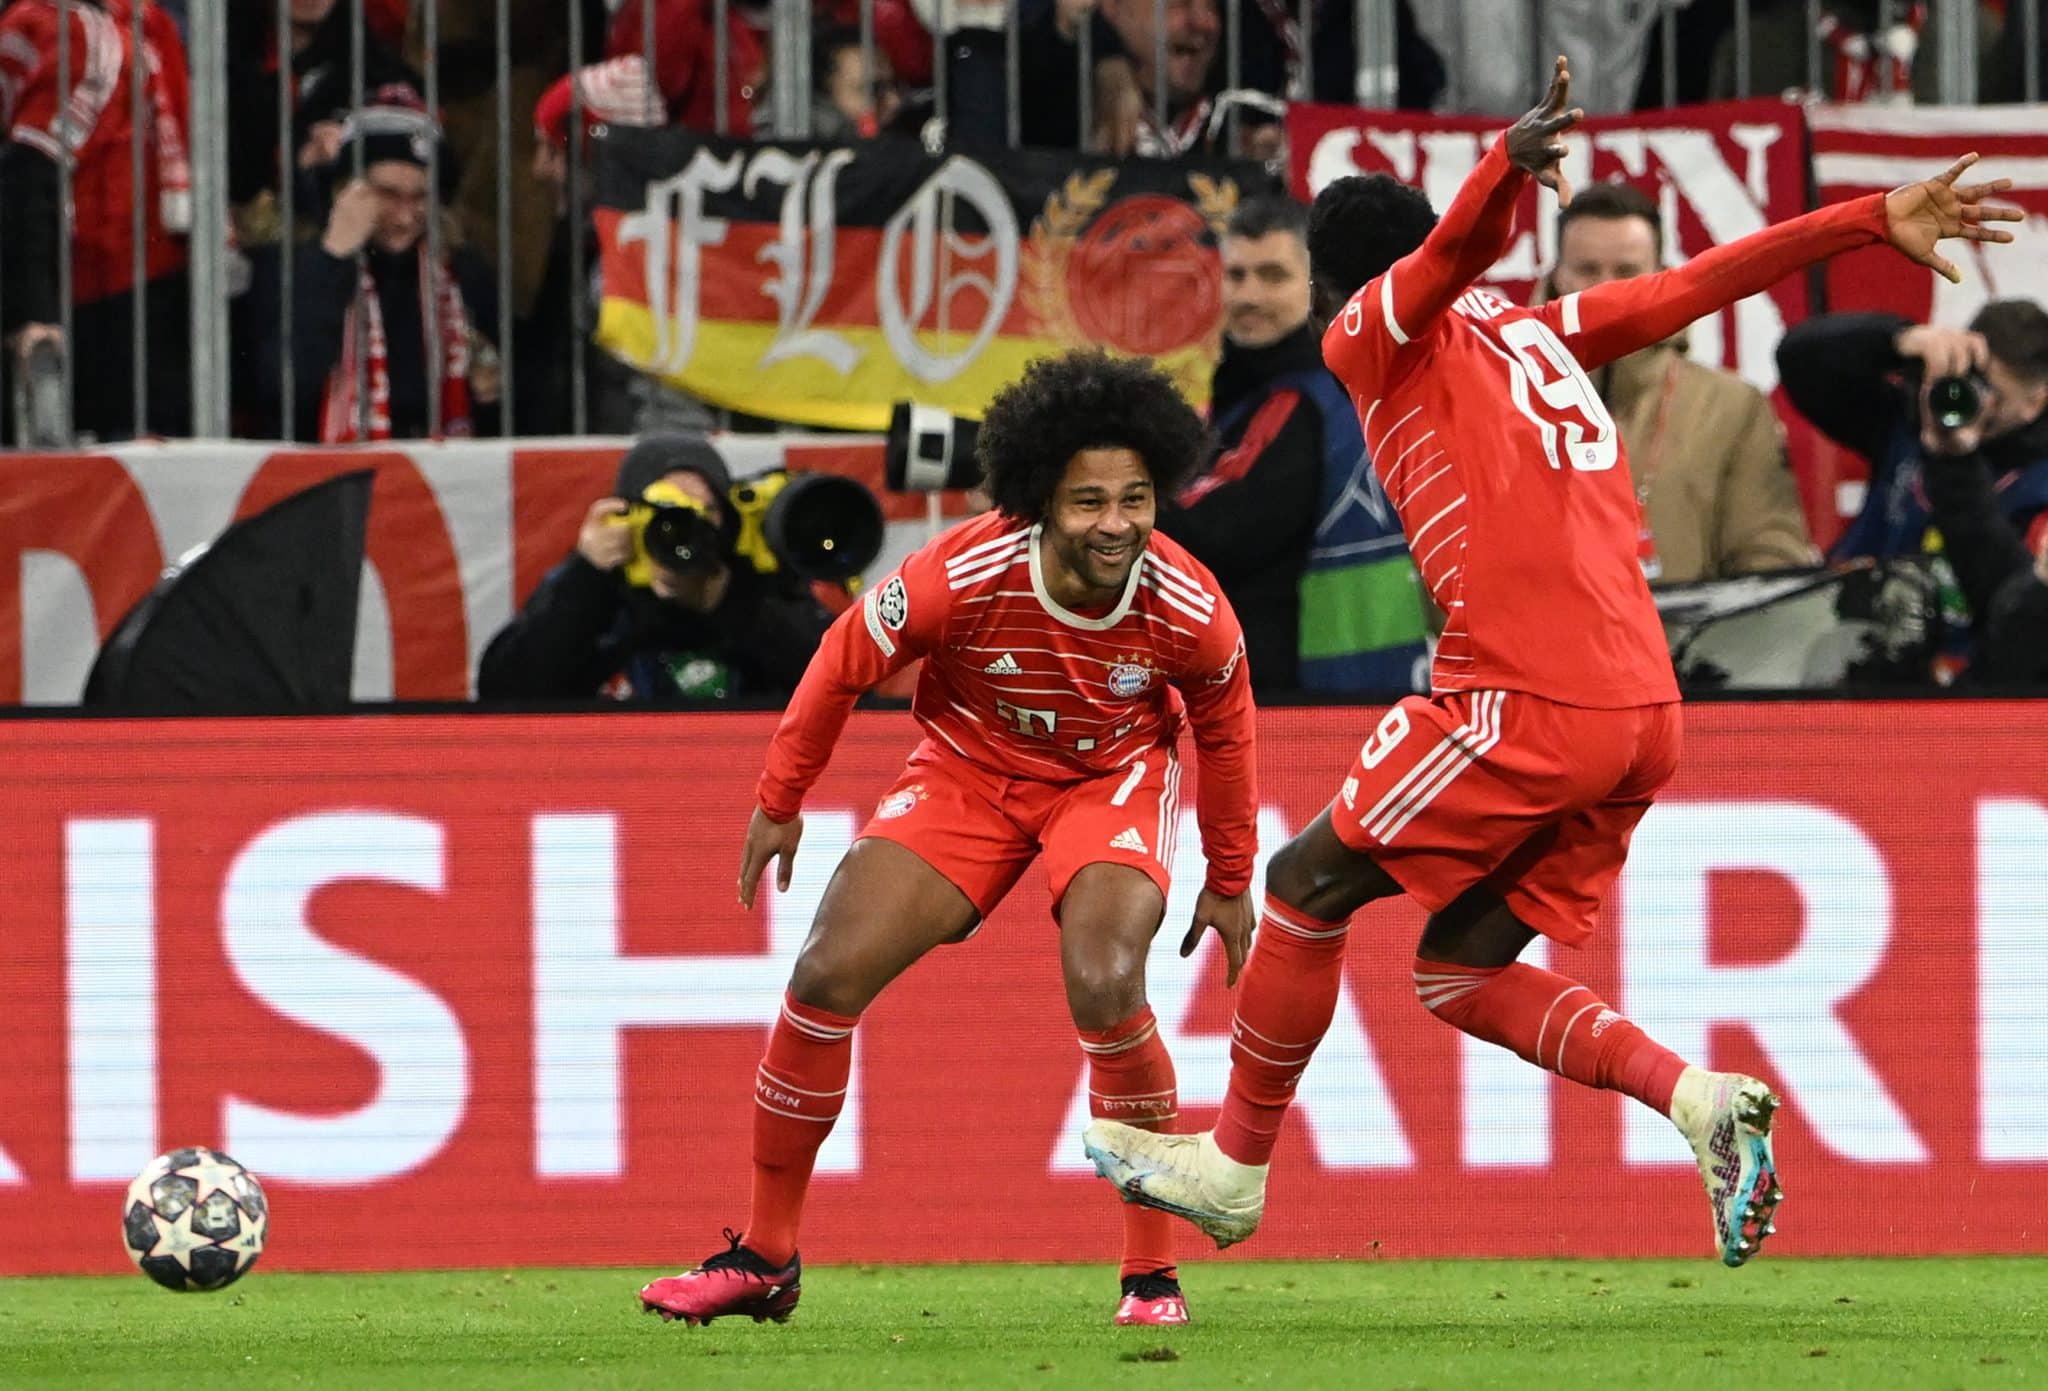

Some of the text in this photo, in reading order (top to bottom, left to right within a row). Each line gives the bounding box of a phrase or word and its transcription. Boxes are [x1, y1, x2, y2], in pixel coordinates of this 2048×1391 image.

[1470, 318, 1618, 471] 19
[984, 667, 1022, 675] adidas
[1361, 706, 1411, 769] 9
[0, 810, 862, 1184] ISH
